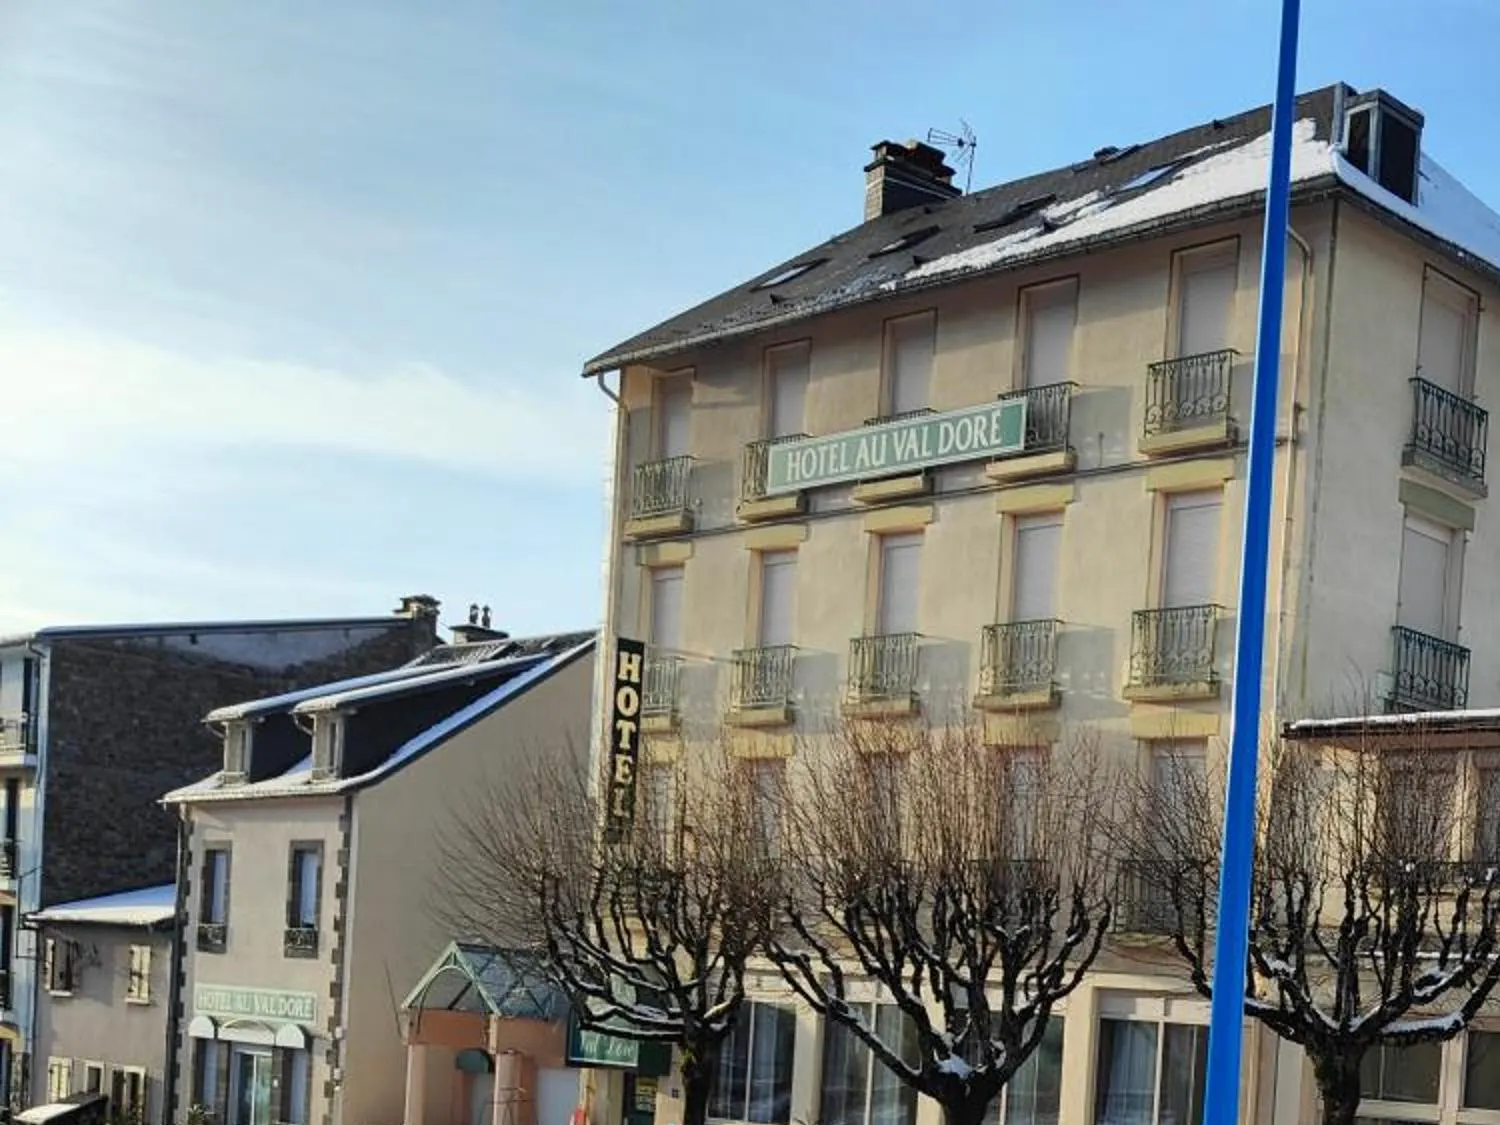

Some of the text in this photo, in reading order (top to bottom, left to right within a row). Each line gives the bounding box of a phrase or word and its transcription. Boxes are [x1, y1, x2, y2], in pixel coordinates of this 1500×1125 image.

[786, 442, 848, 481] HOTEL
[856, 434, 888, 468] AU
[893, 425, 932, 459] VAL
[613, 651, 642, 818] HOTEL
[253, 992, 276, 1015] VAL
